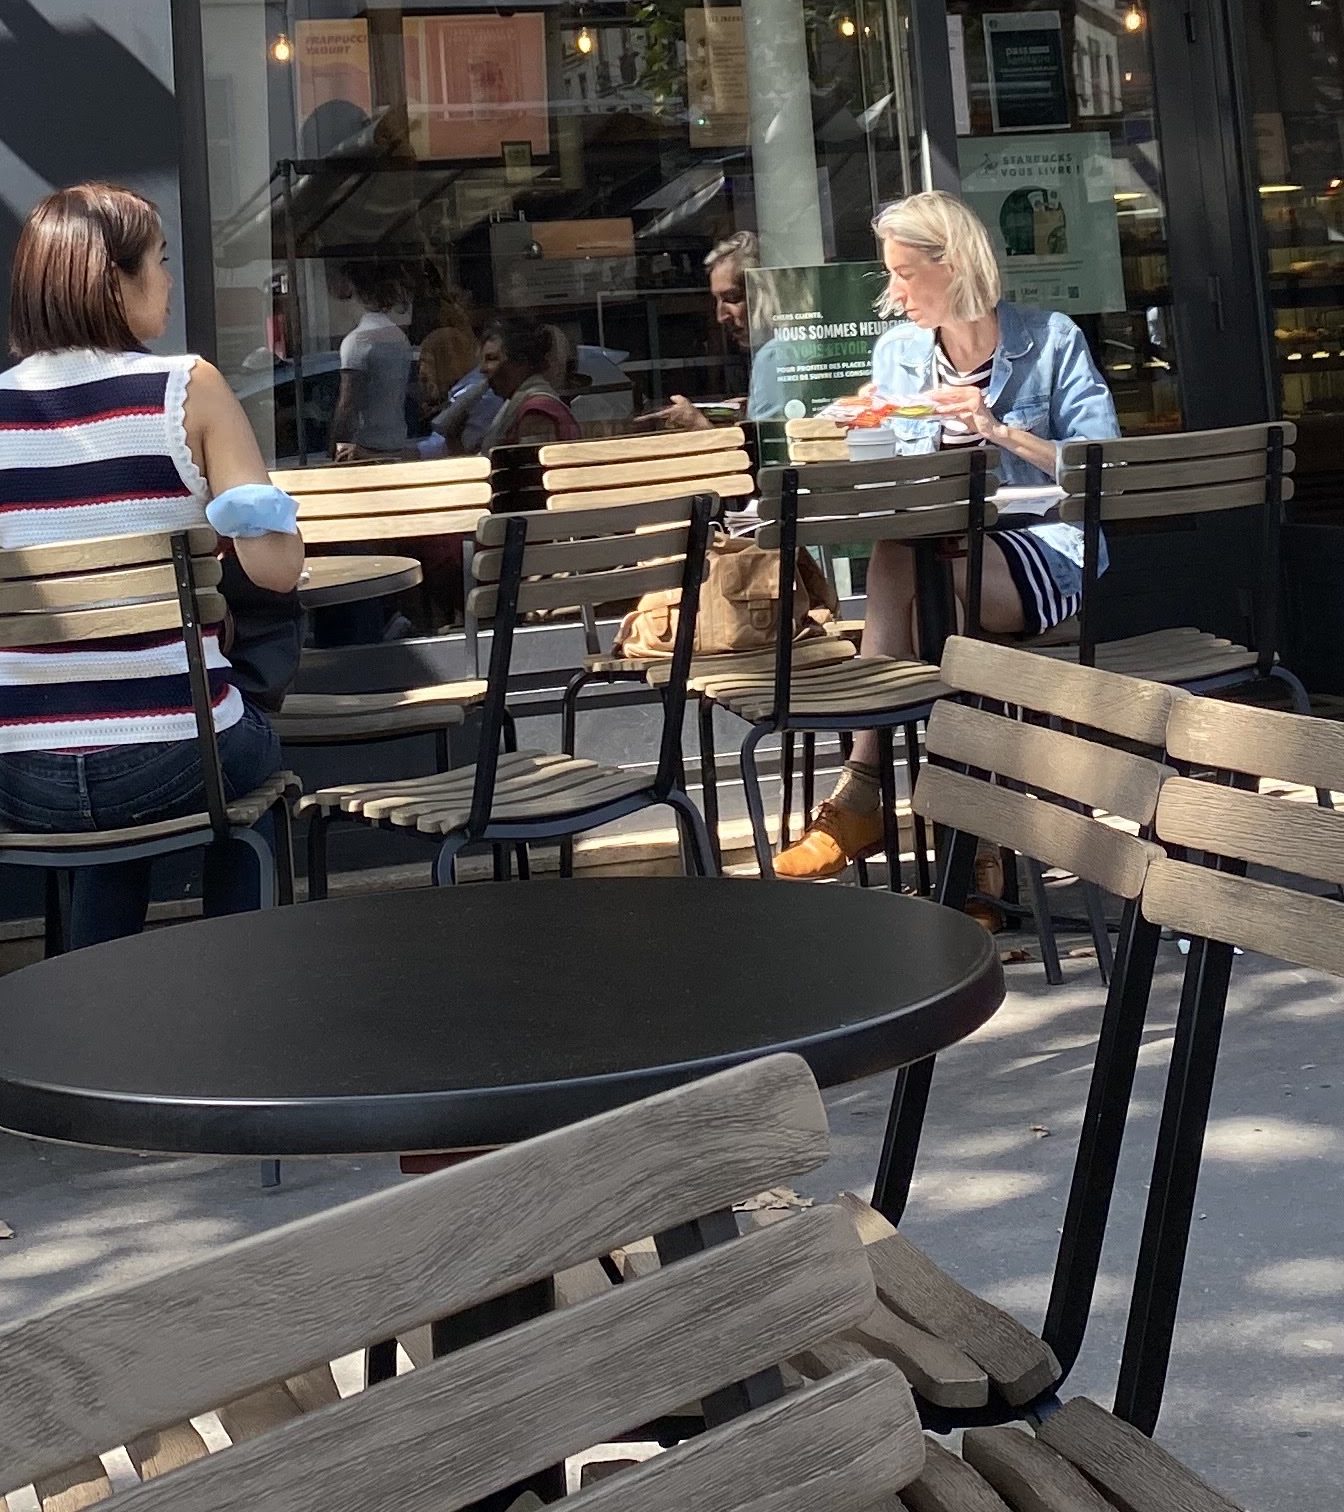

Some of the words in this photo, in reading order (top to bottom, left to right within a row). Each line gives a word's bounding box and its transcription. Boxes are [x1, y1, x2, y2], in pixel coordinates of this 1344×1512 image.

[1003, 153, 1073, 165] STARBUCKS
[1001, 167, 1033, 177] VOUS
[1039, 164, 1072, 176] LIVRE
[774, 326, 807, 342] NOUS
[808, 322, 857, 340] SOMMES
[776, 366, 796, 374] POUR
[776, 374, 799, 383] MERCI
